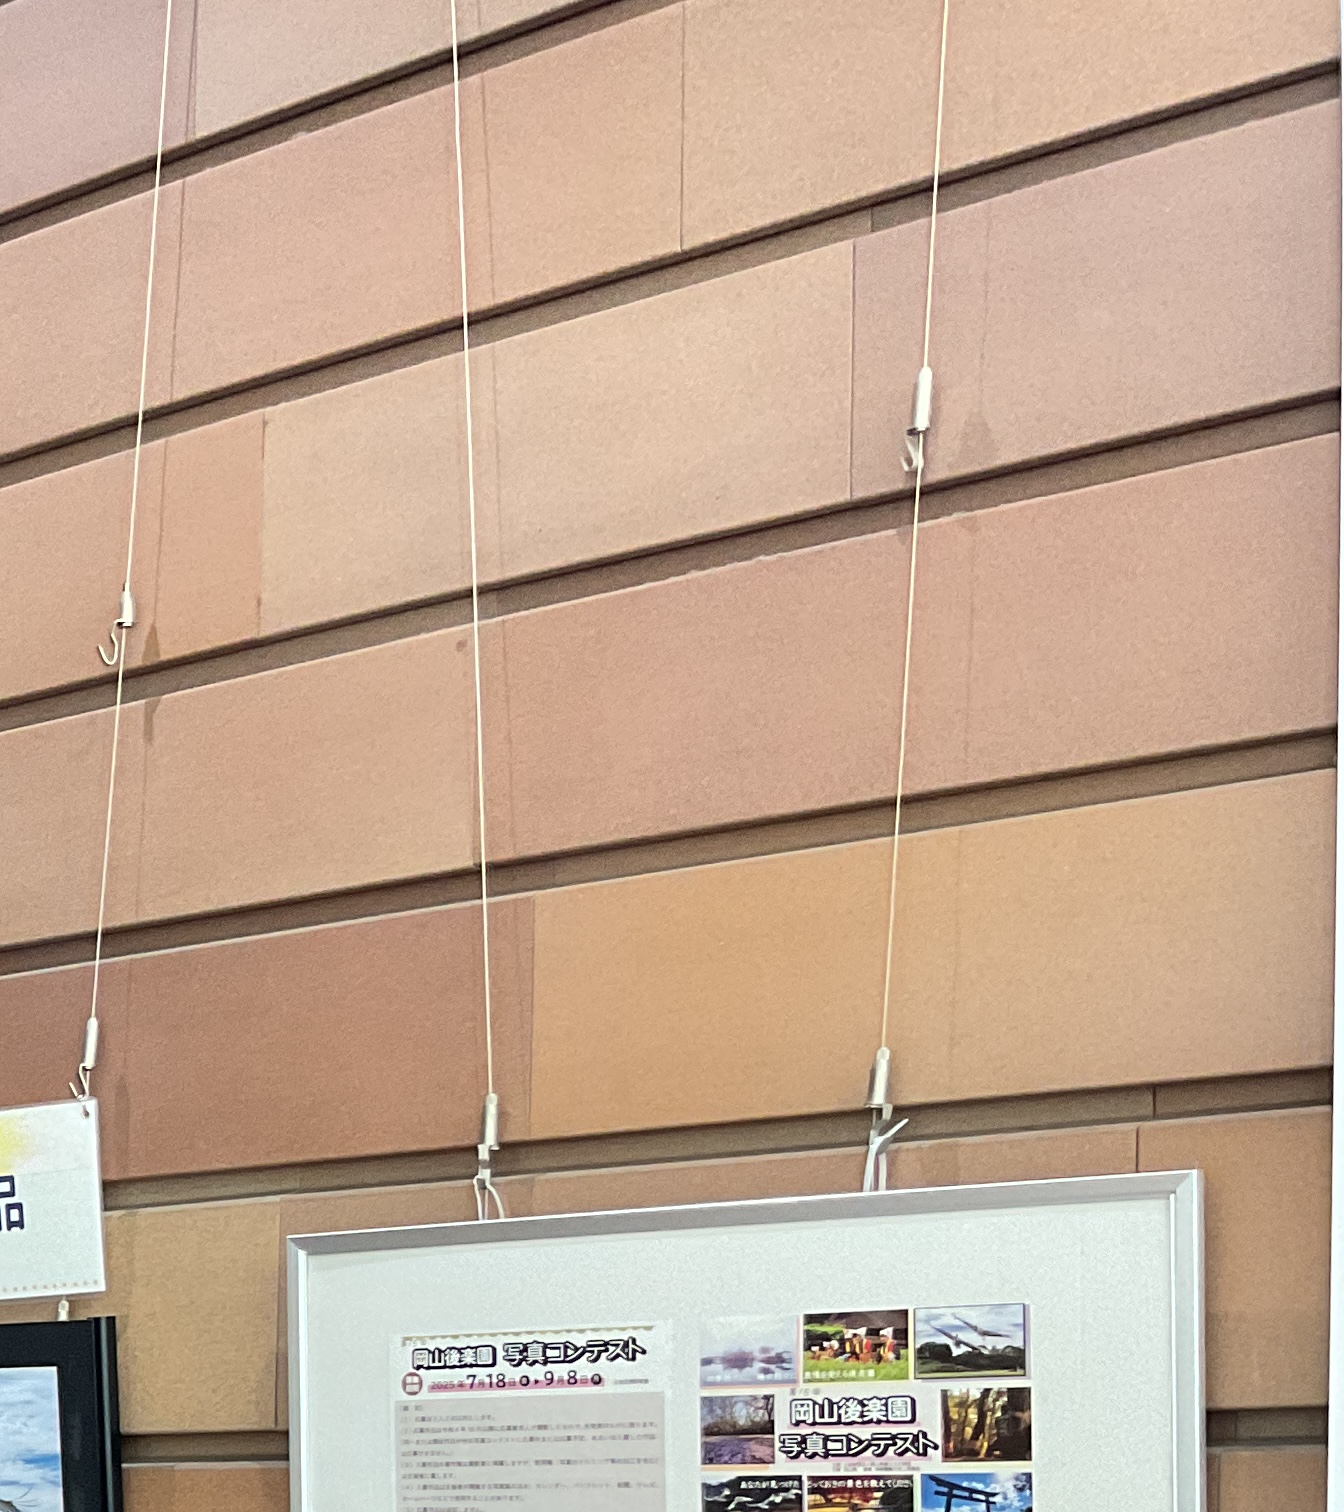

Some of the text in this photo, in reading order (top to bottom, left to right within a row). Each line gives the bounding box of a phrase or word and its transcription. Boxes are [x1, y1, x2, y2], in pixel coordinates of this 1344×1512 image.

[411, 1335, 647, 1371] 岡山後楽園 写真コンテスト
[789, 1396, 917, 1427] 岡山後楽園
[779, 1430, 940, 1459] 写真コンテスト
